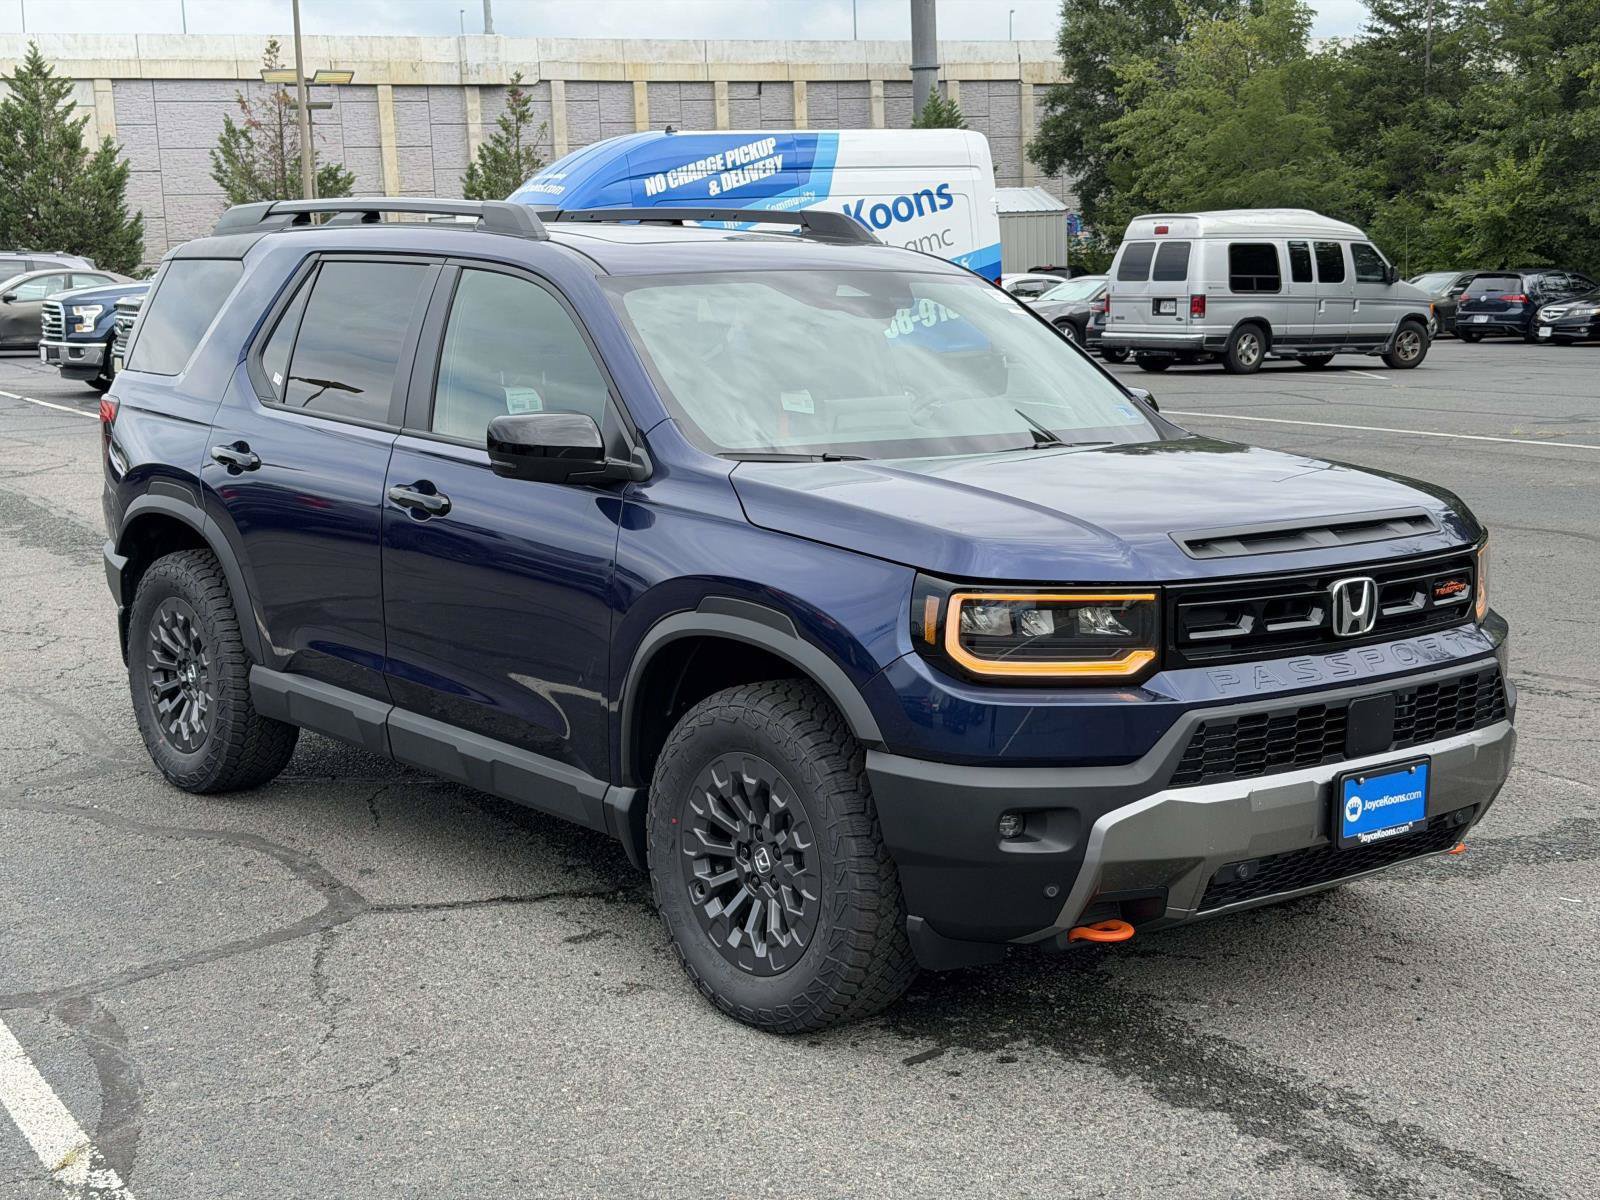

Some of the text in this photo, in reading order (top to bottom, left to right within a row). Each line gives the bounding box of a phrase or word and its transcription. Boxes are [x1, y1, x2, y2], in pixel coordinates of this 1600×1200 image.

[643, 137, 777, 197] NO CHARGE PICKUP
[708, 154, 784, 197] & DELIVERY
[842, 182, 954, 233] Koons
[1206, 632, 1470, 694] PASSPORT
[1363, 790, 1422, 812] JoyceKoons.com
[1360, 825, 1410, 843] JoyceKoons.com
